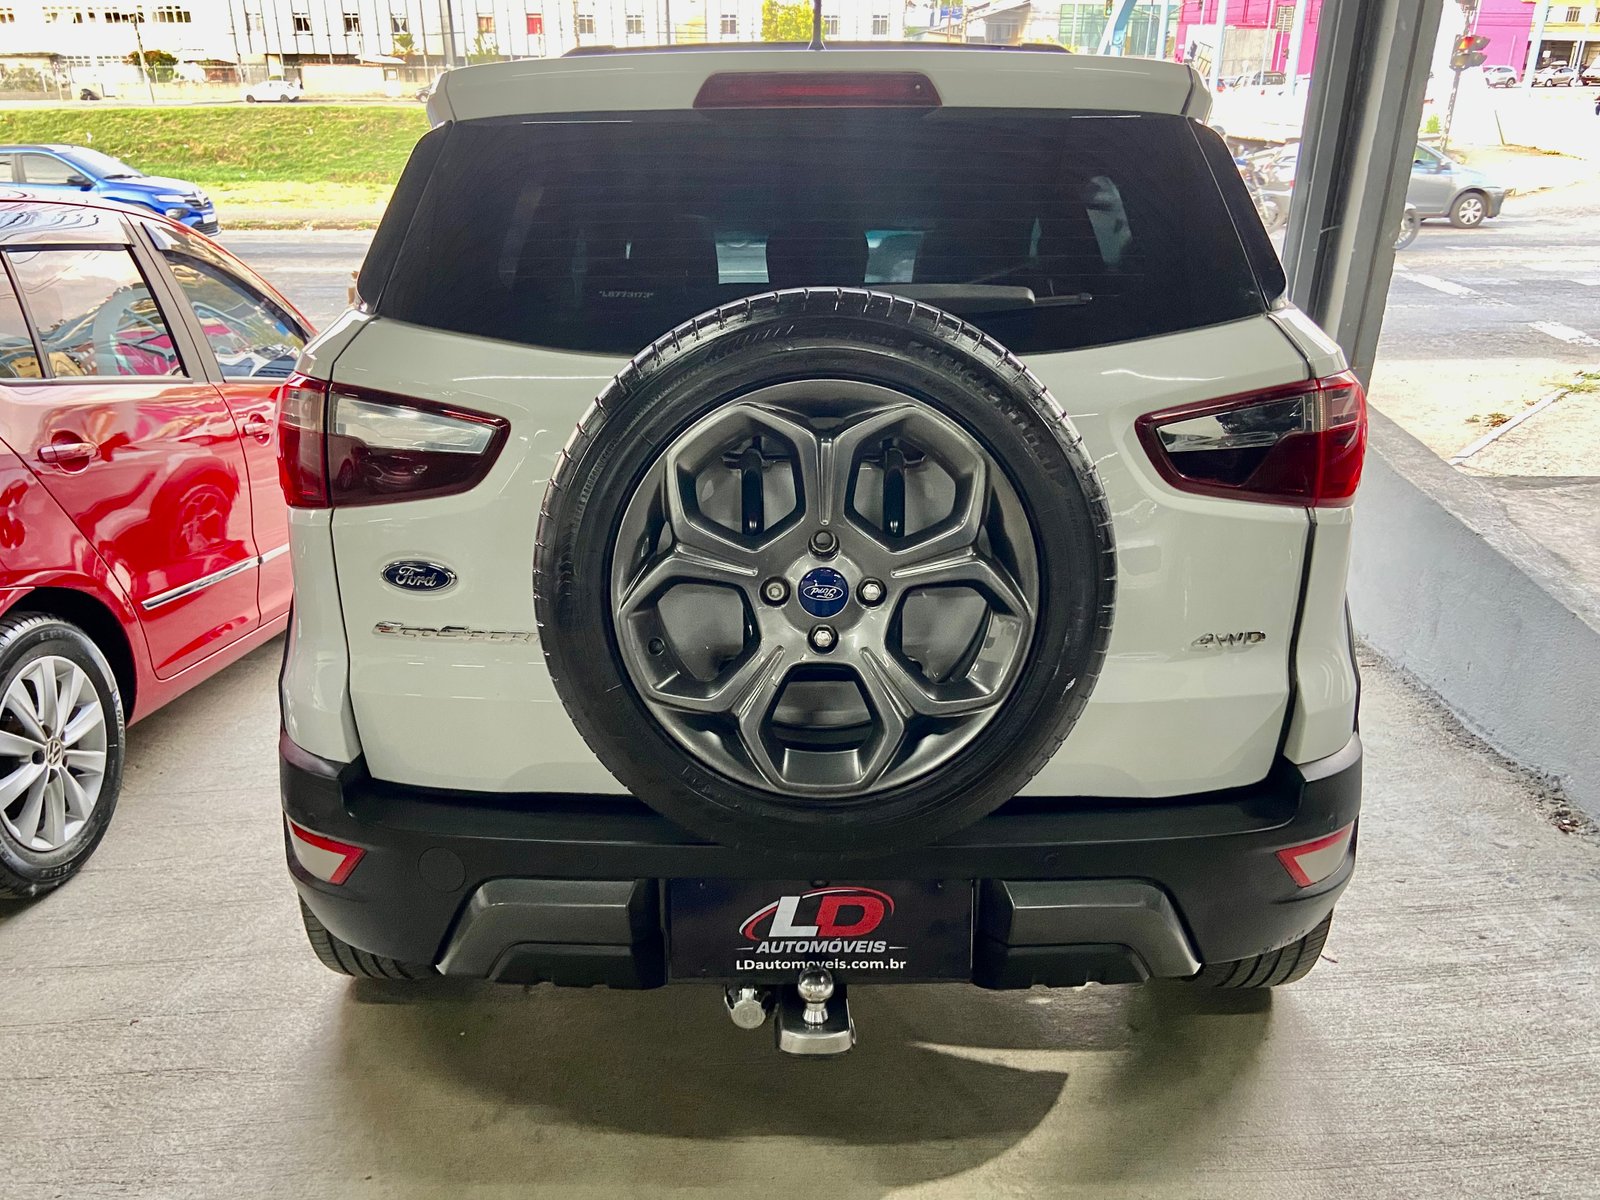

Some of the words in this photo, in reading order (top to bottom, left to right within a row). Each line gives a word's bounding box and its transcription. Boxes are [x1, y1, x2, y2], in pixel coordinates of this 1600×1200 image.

[395, 565, 437, 588] Ford
[809, 587, 837, 599] Ford
[768, 896, 885, 938] LD
[755, 938, 887, 954] AUTOMÓVEIS
[735, 958, 907, 970] LDautomoveis.com.br
